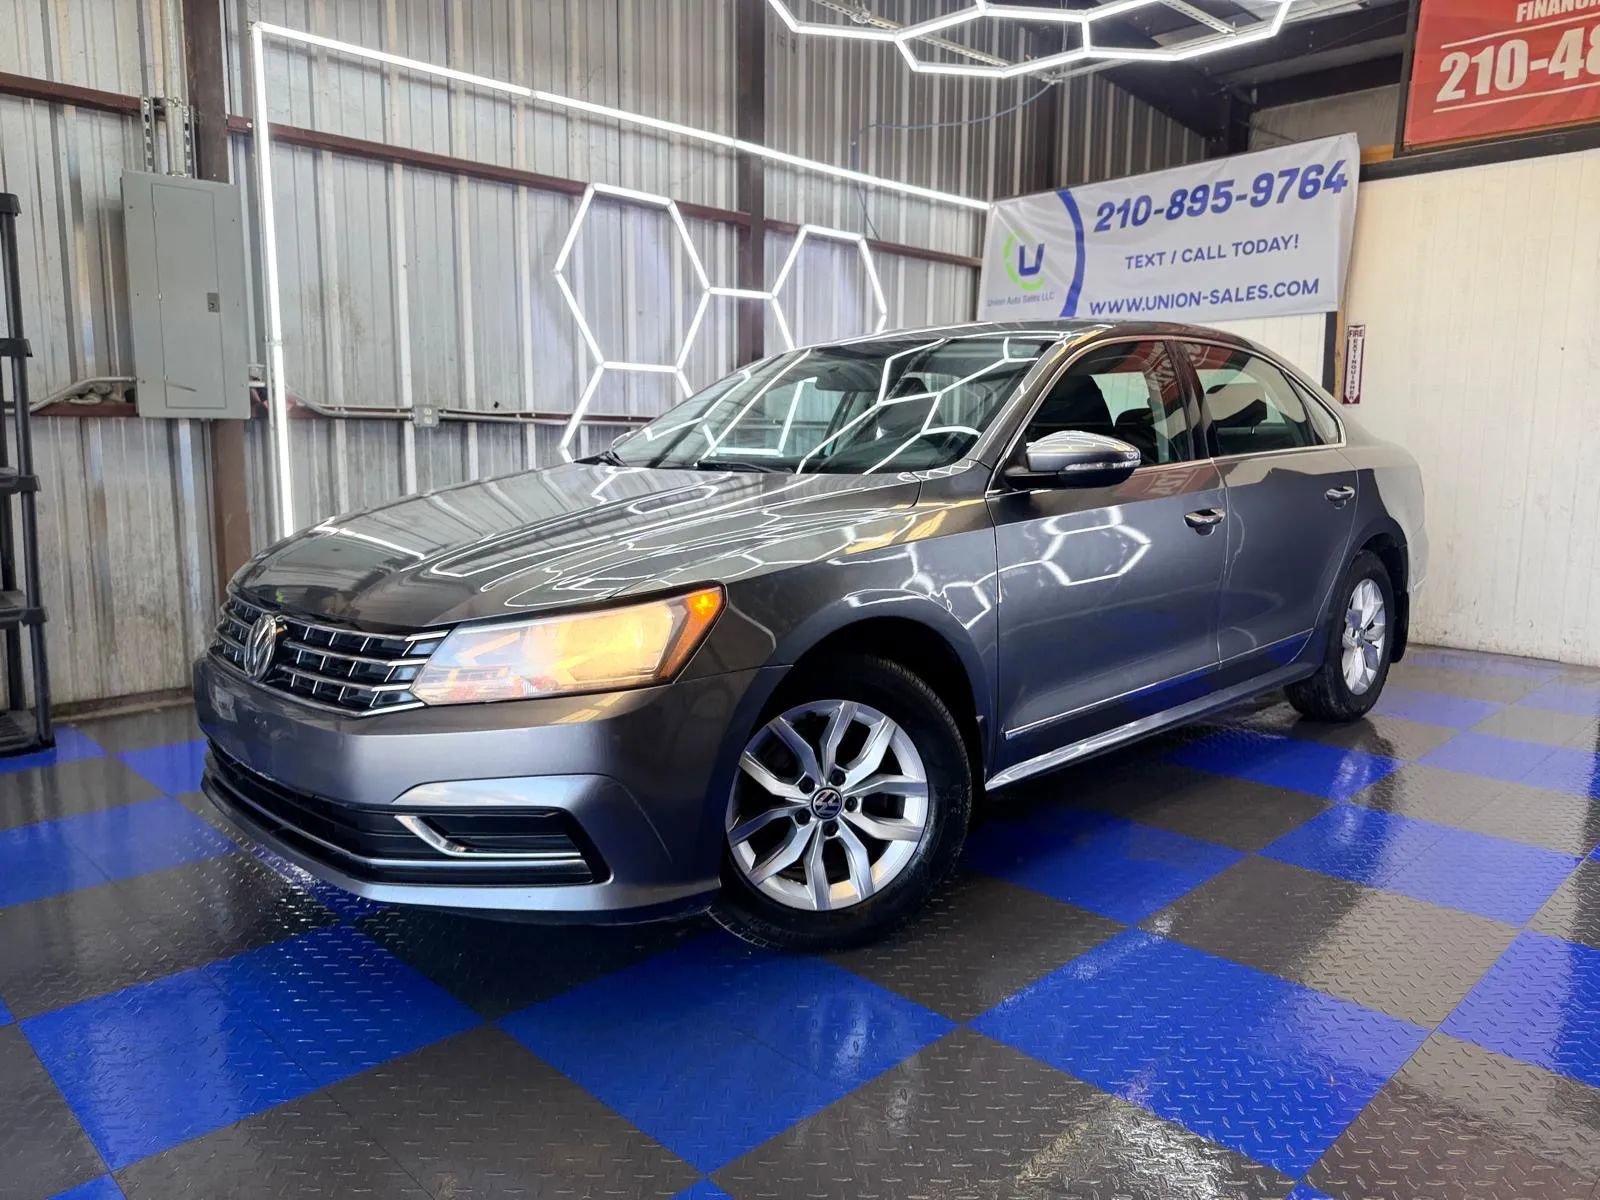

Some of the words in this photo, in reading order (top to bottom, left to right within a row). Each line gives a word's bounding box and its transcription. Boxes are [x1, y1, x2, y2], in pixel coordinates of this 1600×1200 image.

[1094, 159, 1348, 233] 210-895-9764
[1125, 251, 1166, 270] TEXT
[1170, 250, 1177, 265] /
[1181, 244, 1227, 264] CALL
[1231, 233, 1300, 258] TODAY!
[1089, 277, 1320, 316] WWW.UNION-SALES.COM
[1349, 329, 1364, 338] FIRE
[1348, 338, 1359, 401] EXTINGUISHER
